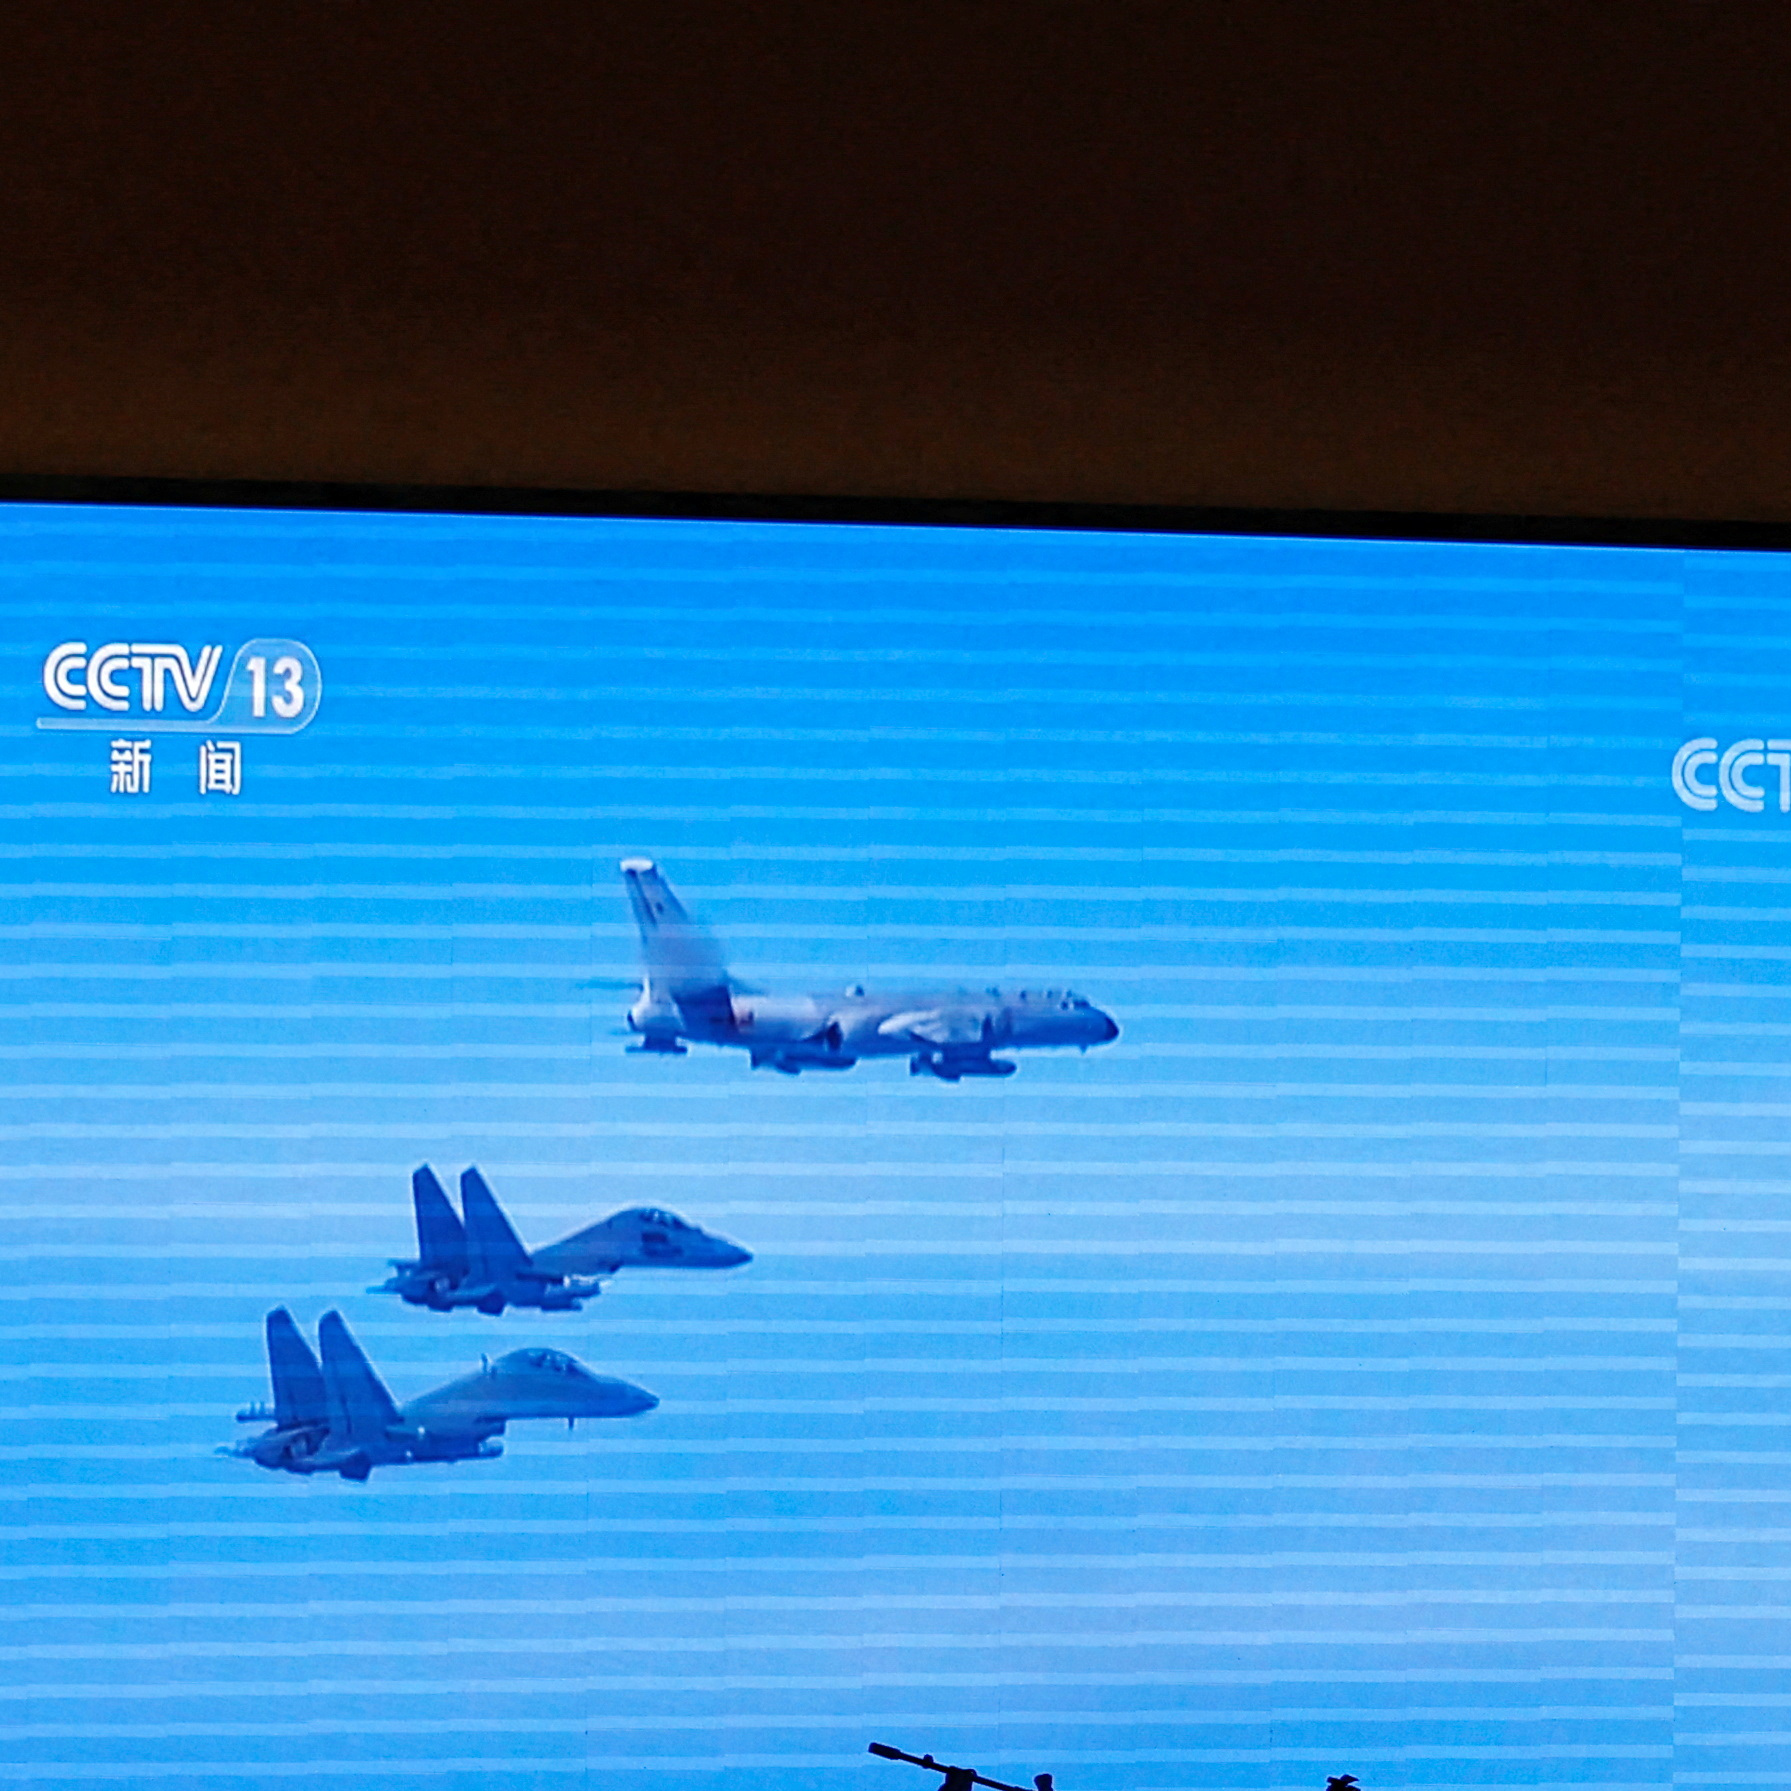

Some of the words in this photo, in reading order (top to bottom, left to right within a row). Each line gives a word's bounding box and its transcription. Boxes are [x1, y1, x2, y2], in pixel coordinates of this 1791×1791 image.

[44, 642, 223, 712] CCTV
[247, 656, 305, 718] 13
[110, 739, 241, 795] 新闻
